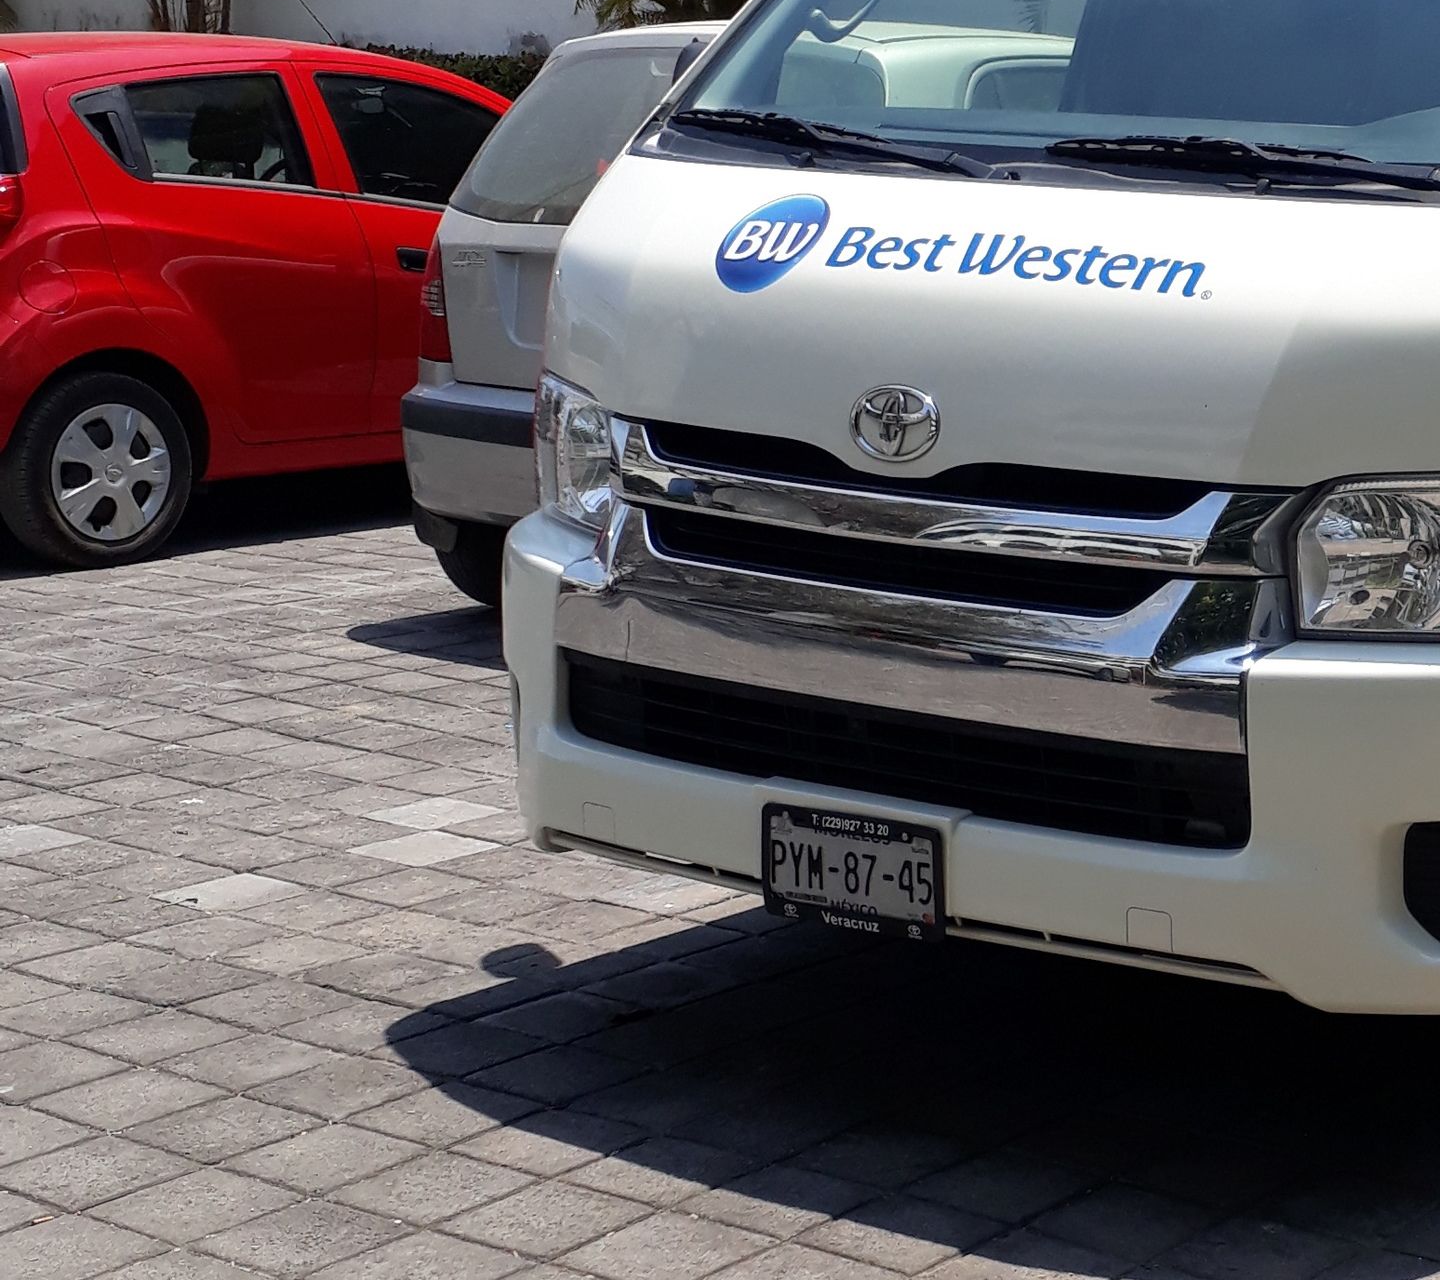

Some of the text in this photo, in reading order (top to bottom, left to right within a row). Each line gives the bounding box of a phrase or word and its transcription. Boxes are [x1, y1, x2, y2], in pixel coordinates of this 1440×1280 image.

[722, 219, 818, 264] BW
[824, 226, 956, 273] Best
[863, 821, 875, 834] 33
[876, 824, 889, 836] 20
[771, 839, 933, 906] PYM-87-45
[821, 910, 880, 933] Veracruz
